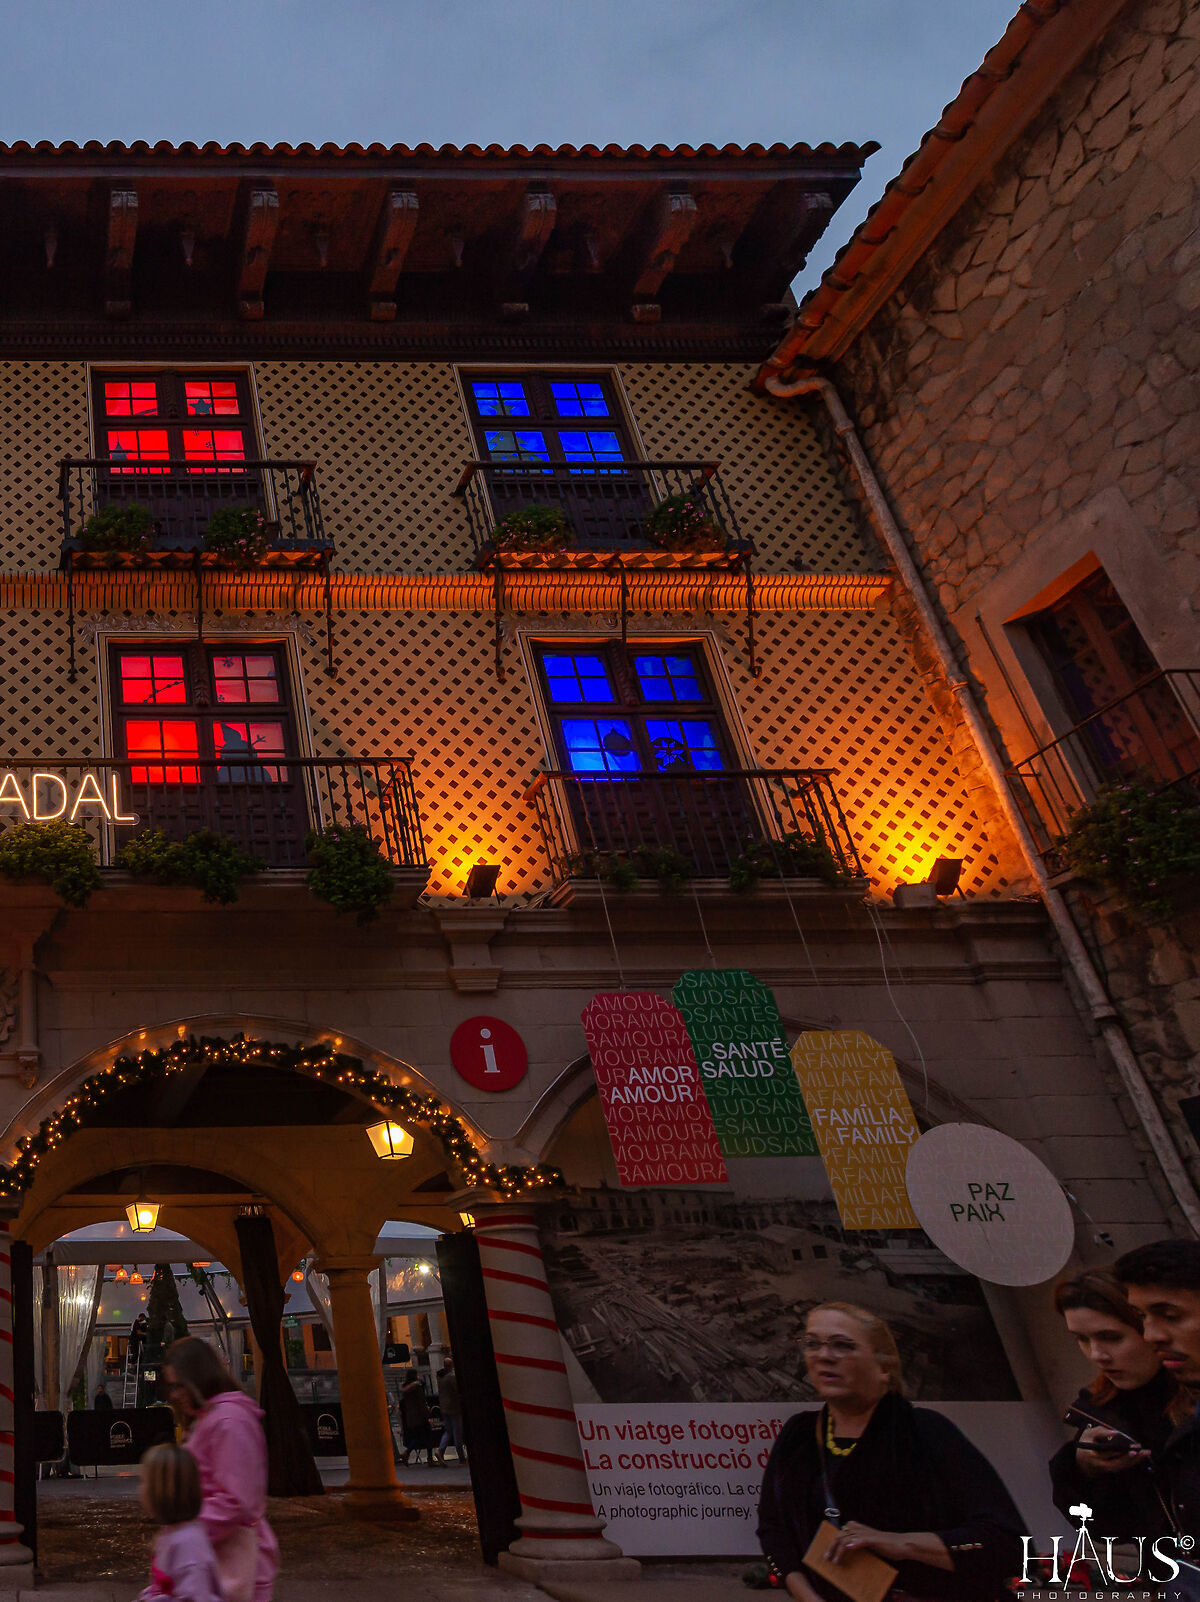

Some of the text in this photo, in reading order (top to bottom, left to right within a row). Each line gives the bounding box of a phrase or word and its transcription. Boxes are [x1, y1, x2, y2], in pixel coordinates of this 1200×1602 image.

[628, 1065, 696, 1085] AMOR
[701, 1060, 775, 1078] SALUD
[610, 1084, 695, 1105] AMOUR
[837, 1126, 915, 1145] FAMILY
[967, 1181, 1016, 1201] PAZ
[949, 1203, 1006, 1223] PAIX
[578, 1418, 784, 1445] Un viatge fotogràfi
[584, 1449, 613, 1470] La
[617, 1448, 750, 1470] construcció
[592, 1482, 612, 1496] Un
[614, 1482, 646, 1498] viaje
[649, 1482, 725, 1499] fotográfico.
[727, 1482, 745, 1496] La
[597, 1505, 608, 1518] A
[610, 1503, 698, 1520] photographic
[701, 1504, 752, 1520] journey.
